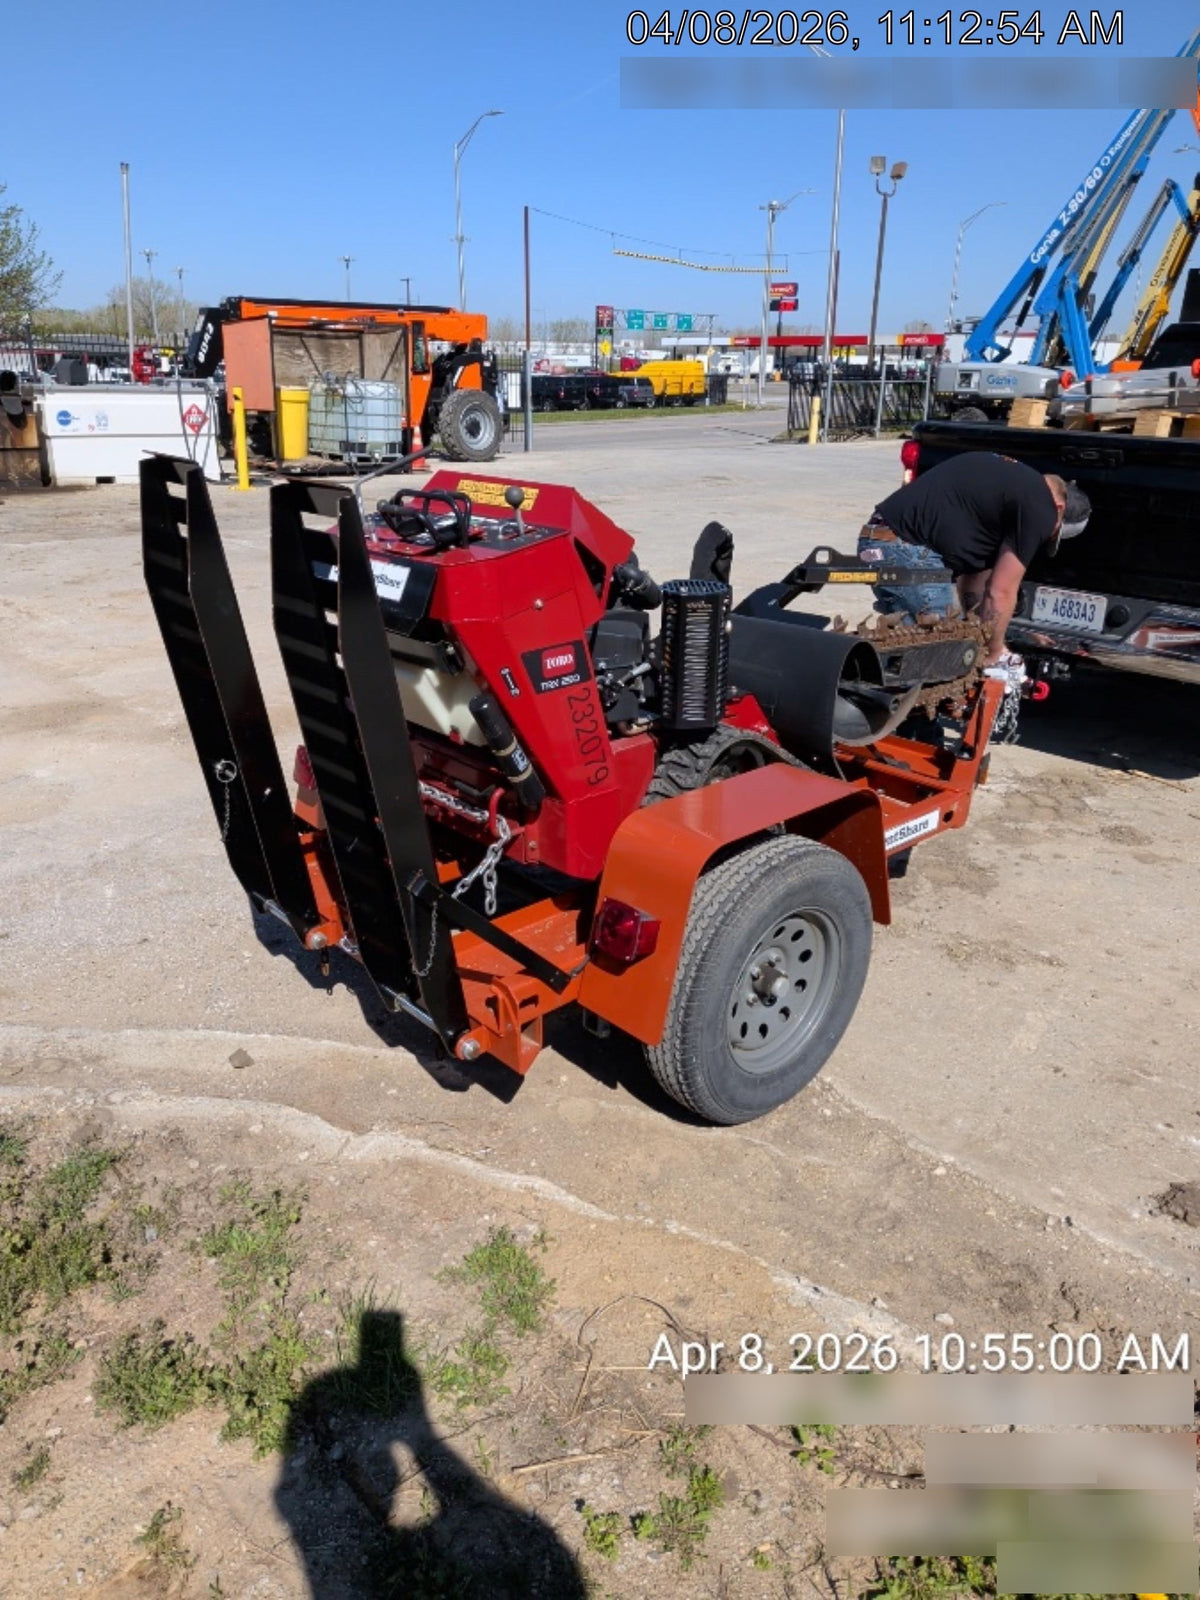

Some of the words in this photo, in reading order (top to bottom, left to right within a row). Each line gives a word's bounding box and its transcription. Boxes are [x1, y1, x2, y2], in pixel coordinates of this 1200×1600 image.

[1030, 229, 1061, 264] Genie
[1059, 166, 1104, 226] Z-80/60
[1052, 597, 1096, 623] A683A3
[546, 653, 574, 669] TORO
[567, 687, 610, 786] 232079
